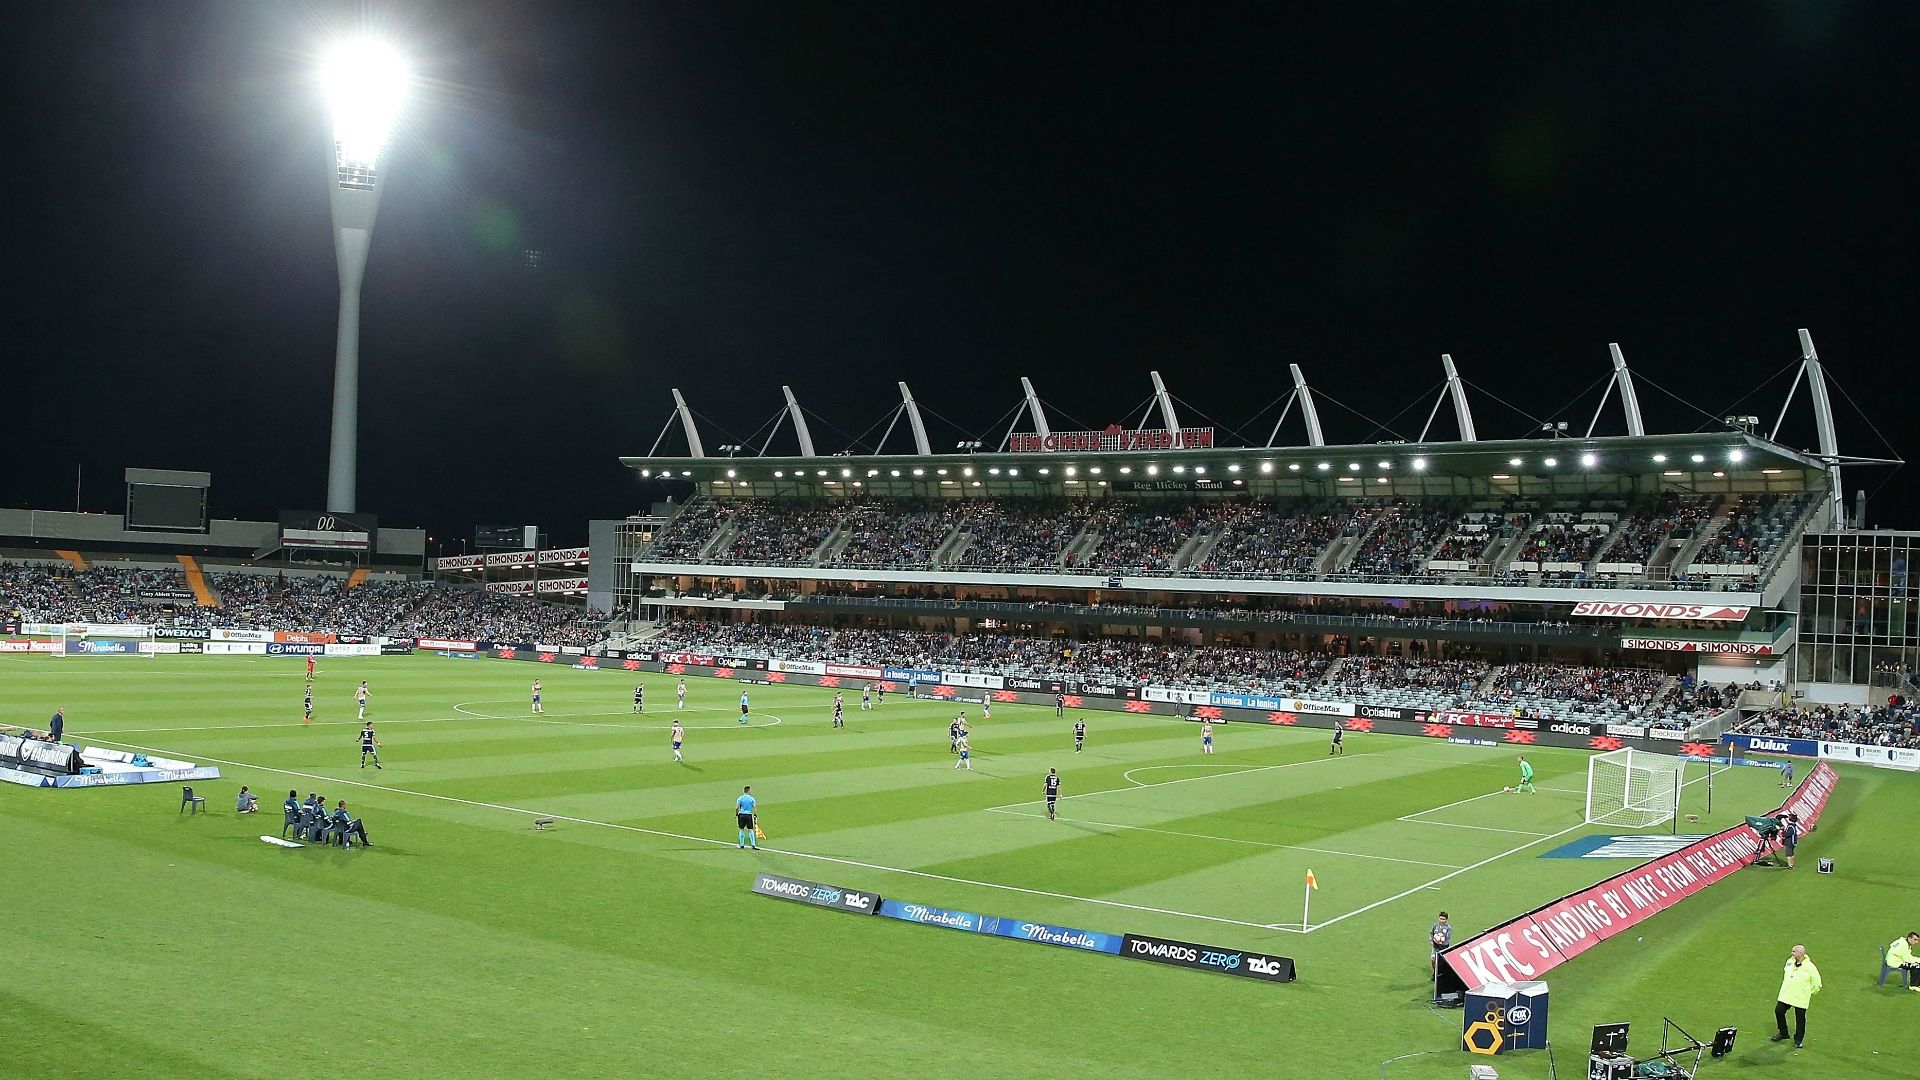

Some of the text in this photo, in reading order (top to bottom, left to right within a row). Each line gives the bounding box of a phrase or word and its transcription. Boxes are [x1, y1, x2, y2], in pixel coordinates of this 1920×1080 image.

[1010, 431, 1213, 450] SIMONDS STADIUM
[1134, 480, 1223, 490] Reg Hickey Stand
[488, 553, 523, 565] SIMONDS
[540, 550, 577, 562] SIMONDS
[439, 557, 473, 568] SIMONDS
[487, 583, 522, 593] SIMONDS
[539, 580, 576, 591] SIMONDS
[1575, 603, 1703, 618] SIMONDS
[148, 628, 209, 639] POWERADE
[79, 641, 126, 653] Mirabella
[285, 645, 324, 654] HYUNDAI
[1627, 639, 1680, 650] SIMONDS
[1701, 642, 1756, 654] SIMONDS
[626, 652, 652, 661] adidas
[786, 663, 815, 671] OfficeMax
[884, 670, 893, 678] La
[893, 671, 910, 680] Ionica
[914, 673, 922, 681] La
[922, 673, 940, 682] Ionica
[1008, 678, 1041, 689] Optislim
[1082, 683, 1116, 697] Optislim
[1211, 694, 1220, 704] La
[1220, 695, 1243, 706] Ionica
[1247, 698, 1256, 708] La
[1256, 699, 1278, 709] Ionica
[1303, 703, 1341, 713] OfficeMax
[1361, 706, 1401, 718] Optislim
[1550, 722, 1591, 735] adidas
[1607, 725, 1644, 735] checkpoint
[1650, 729, 1684, 739] checkpoin
[1750, 738, 1789, 752] Dulux
[158, 770, 205, 781] Mirabella
[761, 877, 809, 897] TOWARDS
[844, 892, 870, 909] TAC
[1459, 931, 1536, 987] KFC
[1522, 898, 1613, 959] STANDING
[1602, 888, 1632, 920] BY
[1621, 873, 1668, 910] MVFC
[1655, 860, 1698, 892] FROM
[1685, 851, 1718, 878] THE
[1705, 831, 1758, 868] BEGINNING
[903, 904, 972, 928] Mirabella
[1021, 923, 1095, 948] Mirabella
[1130, 939, 1197, 962] TOWARDS
[1246, 957, 1281, 975] TAC
[1512, 1009, 1527, 1020] FOX
